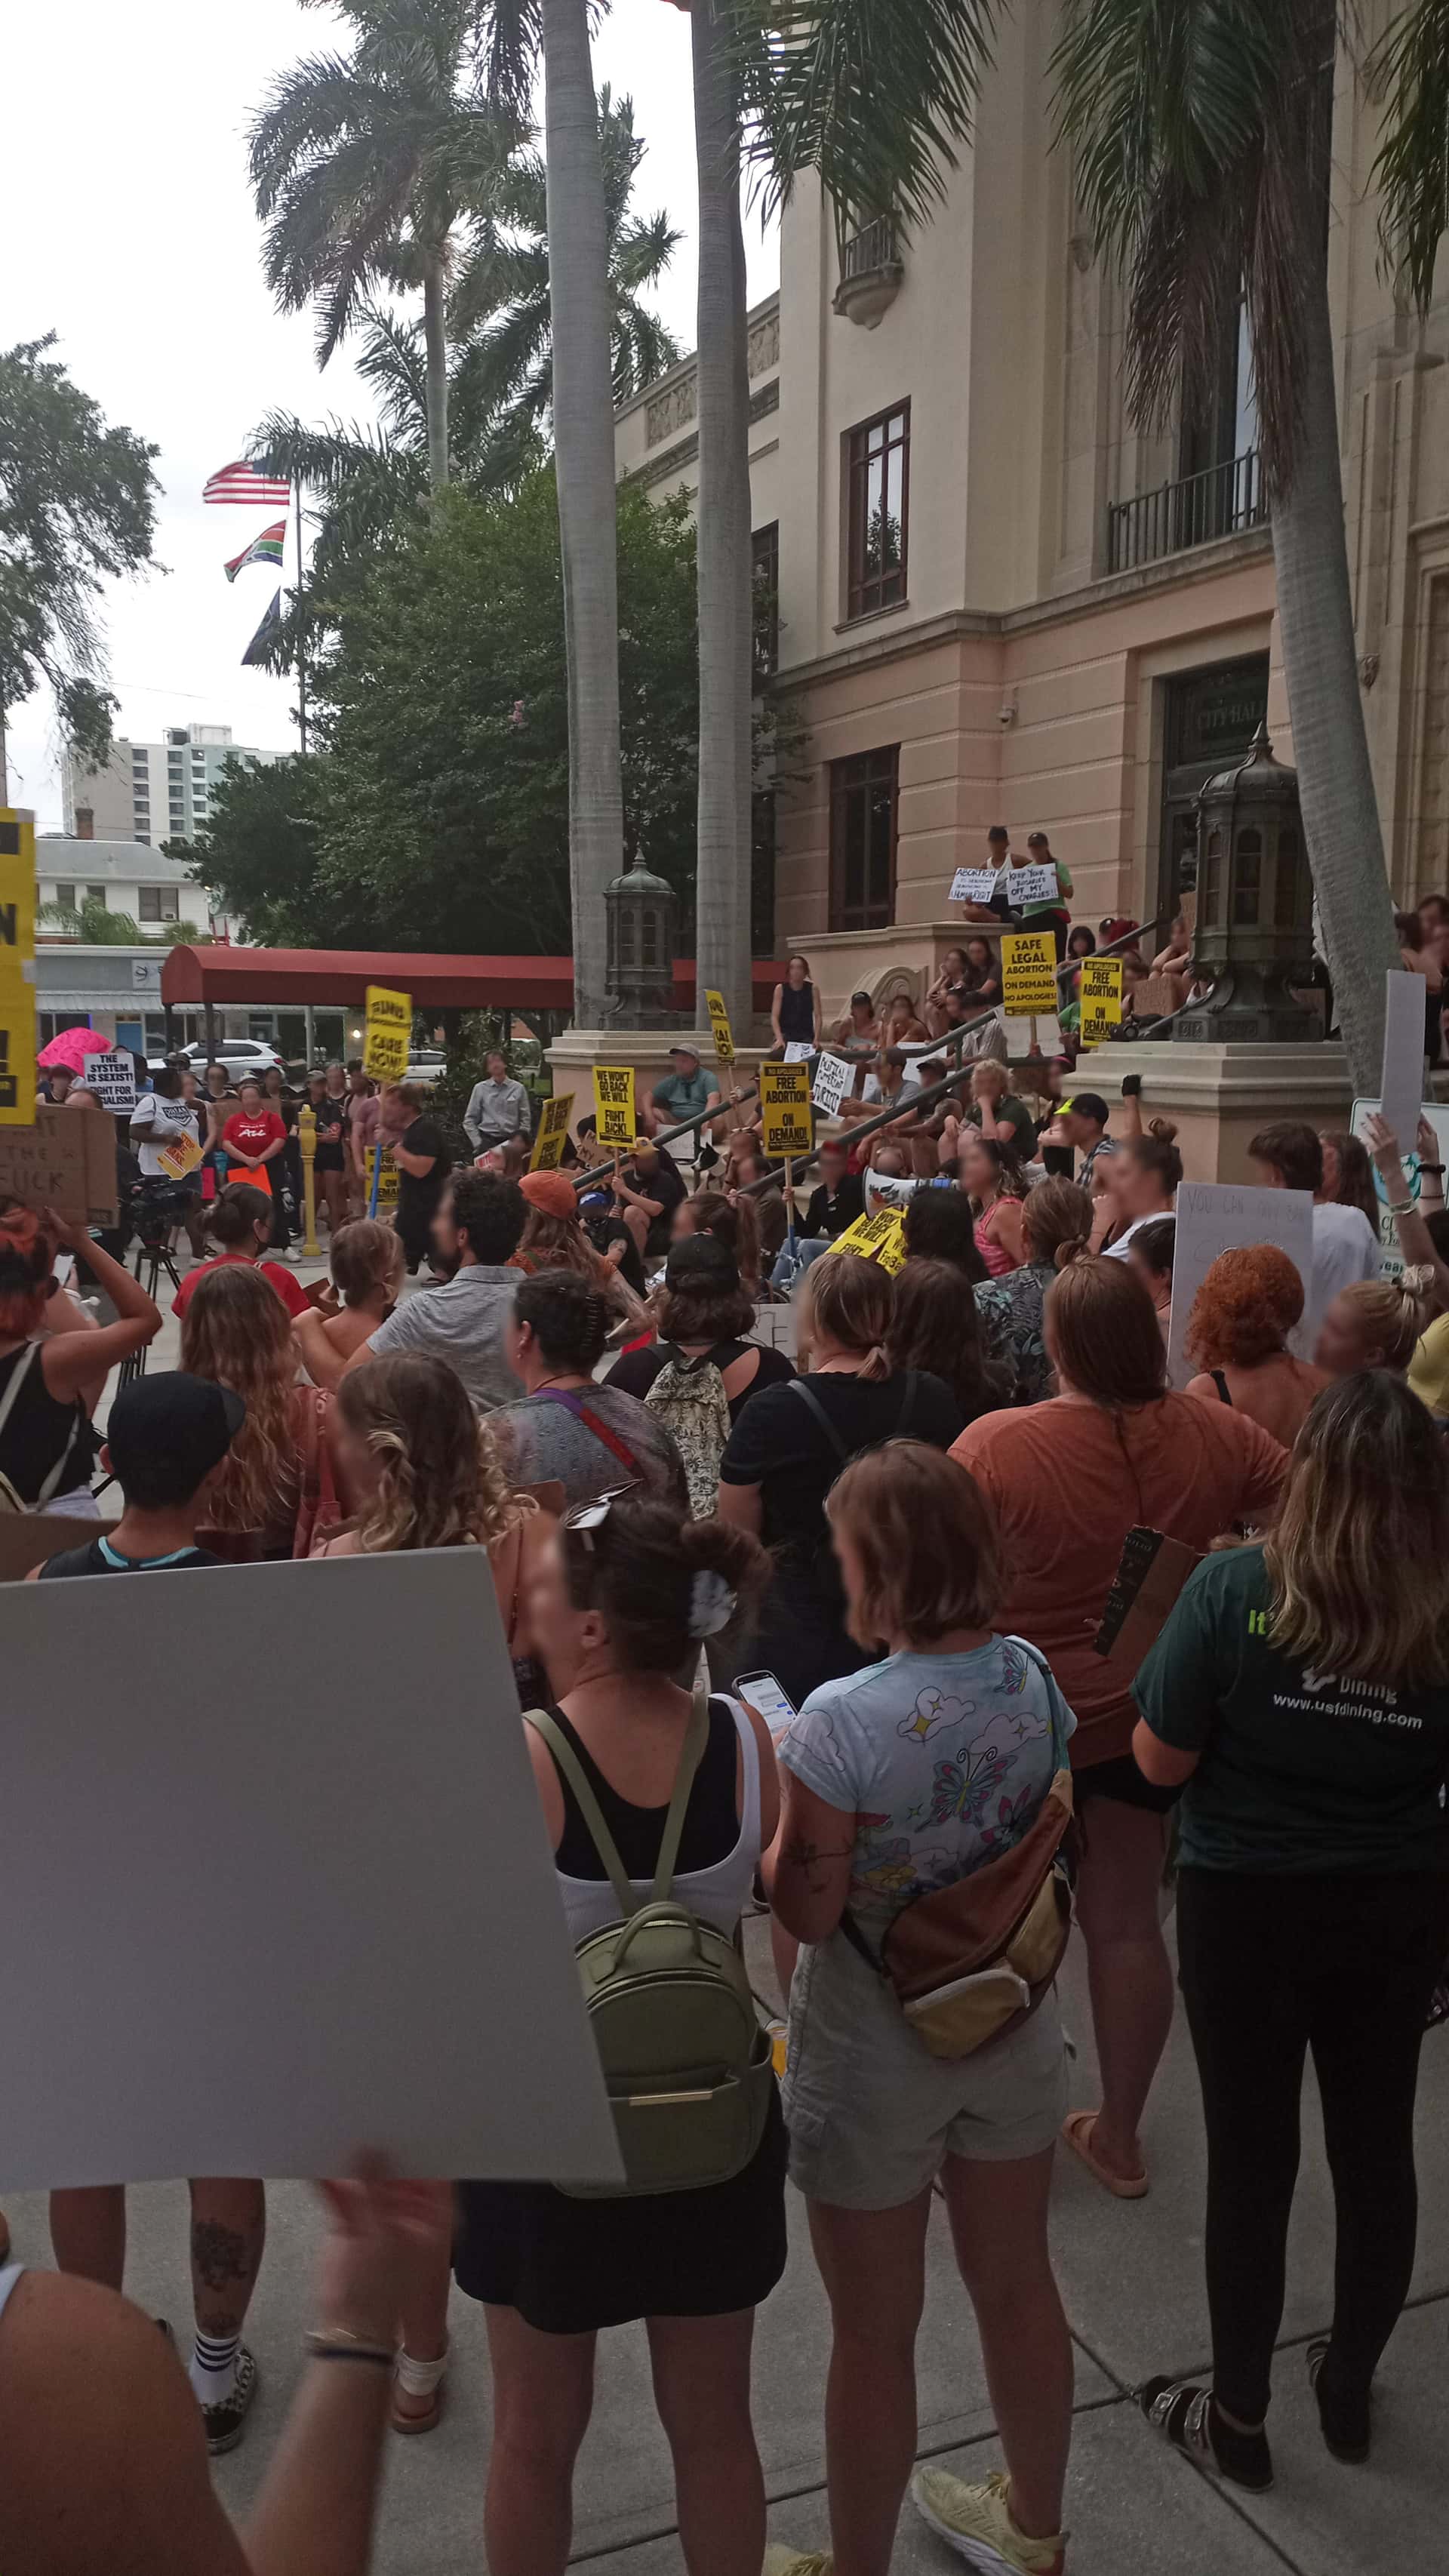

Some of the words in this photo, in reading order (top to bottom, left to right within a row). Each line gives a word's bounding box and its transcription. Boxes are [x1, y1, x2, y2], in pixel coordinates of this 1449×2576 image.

[1196, 707, 1228, 730] CITY
[957, 869, 996, 877] ABORTION
[1014, 939, 1041, 951] SAFE
[1011, 953, 1047, 964] LEGAL
[1006, 965, 1053, 974] ABORTION
[1092, 971, 1110, 984] FREE
[1019, 980, 1055, 989] DEMAND
[1083, 984, 1118, 998] ABORTION
[1095, 1007, 1105, 1018] ON
[100, 1055, 118, 1063] THE
[90, 1064, 128, 1073] SYSTEM
[88, 1073, 97, 1082] IS
[98, 1073, 134, 1082] SEXIST!
[596, 1069, 608, 1081] WE
[599, 1082, 608, 1091] GO
[609, 1082, 628, 1092] BACK
[776, 1077, 797, 1089] FREE
[114, 1086, 132, 1094] FOR
[601, 1091, 611, 1102] WE
[612, 1092, 628, 1103] WILL
[766, 1091, 806, 1103] ABORTION
[605, 1110, 625, 1122] FIGHT
[782, 1113, 794, 1126] ON
[605, 1122, 626, 1135] BACK!
[769, 1127, 807, 1141] DEMAND!
[6, 1145, 48, 1161] THE
[1340, 1676, 1398, 1705] Dining
[1273, 1694, 1423, 1729] www.usfdining.com
